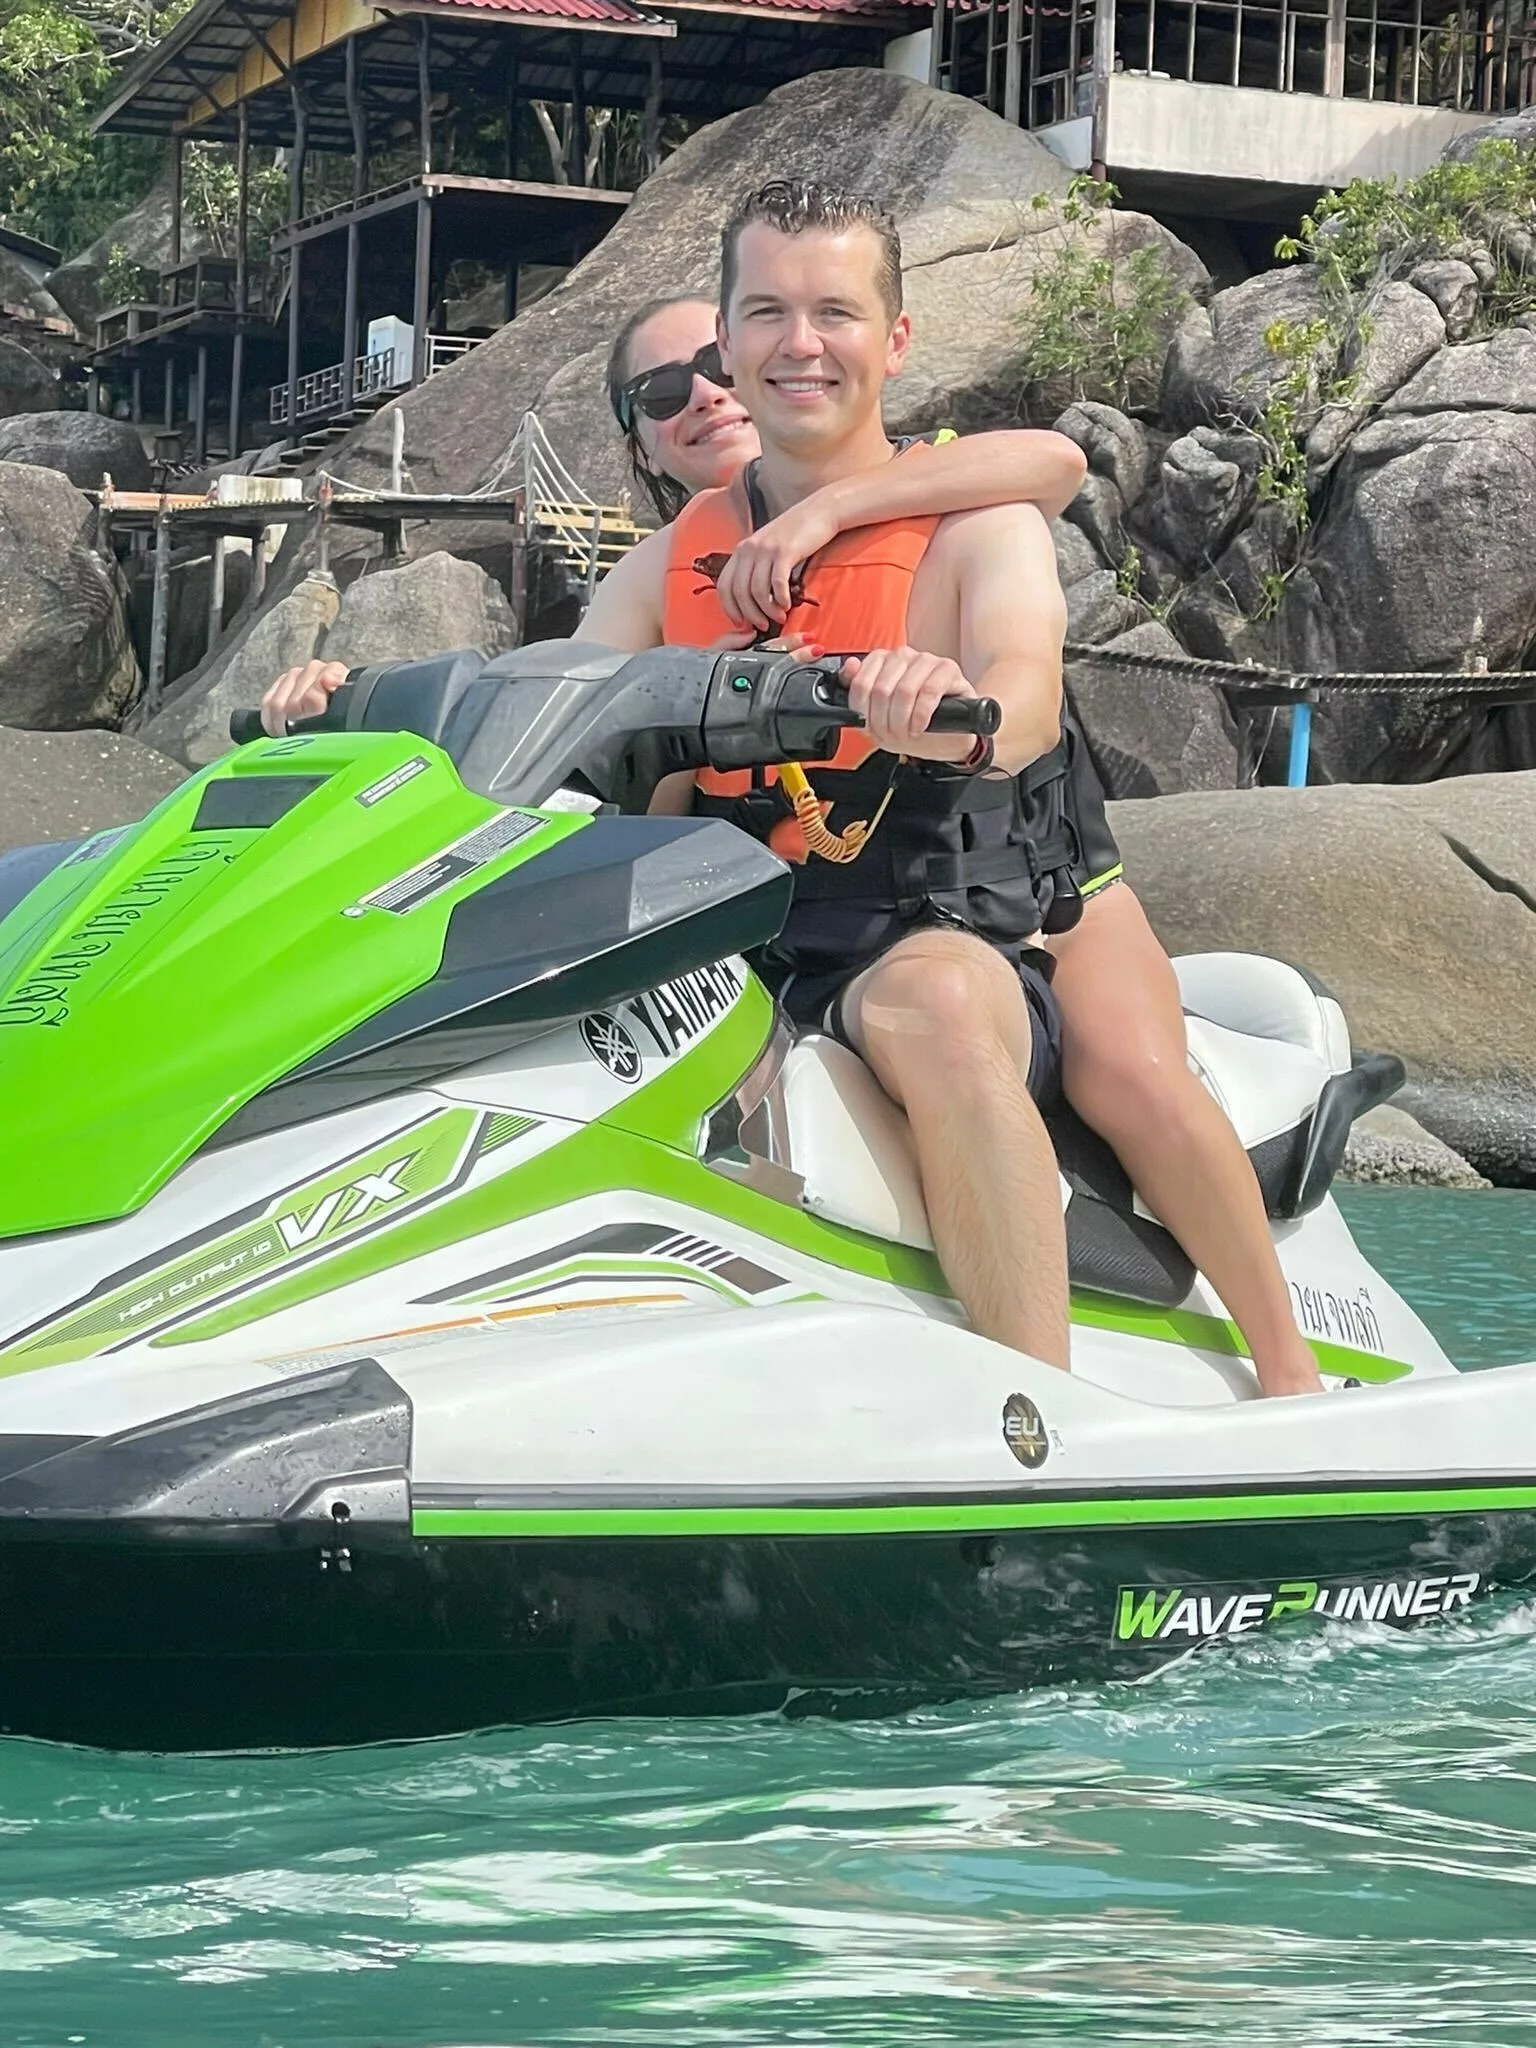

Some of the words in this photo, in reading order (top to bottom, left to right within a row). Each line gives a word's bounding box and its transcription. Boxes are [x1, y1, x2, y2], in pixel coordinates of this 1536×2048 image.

[259, 738, 316, 757] 2
[628, 959, 744, 1058] YAMAHA
[275, 1147, 423, 1251] VX
[119, 1292, 165, 1322] HIGH
[168, 1251, 249, 1297] OUTPUT
[1291, 1281, 1385, 1354] ายเจทสกี
[1005, 1416, 1039, 1436] EU
[1118, 1573, 1481, 1640] WAVERUNNER
